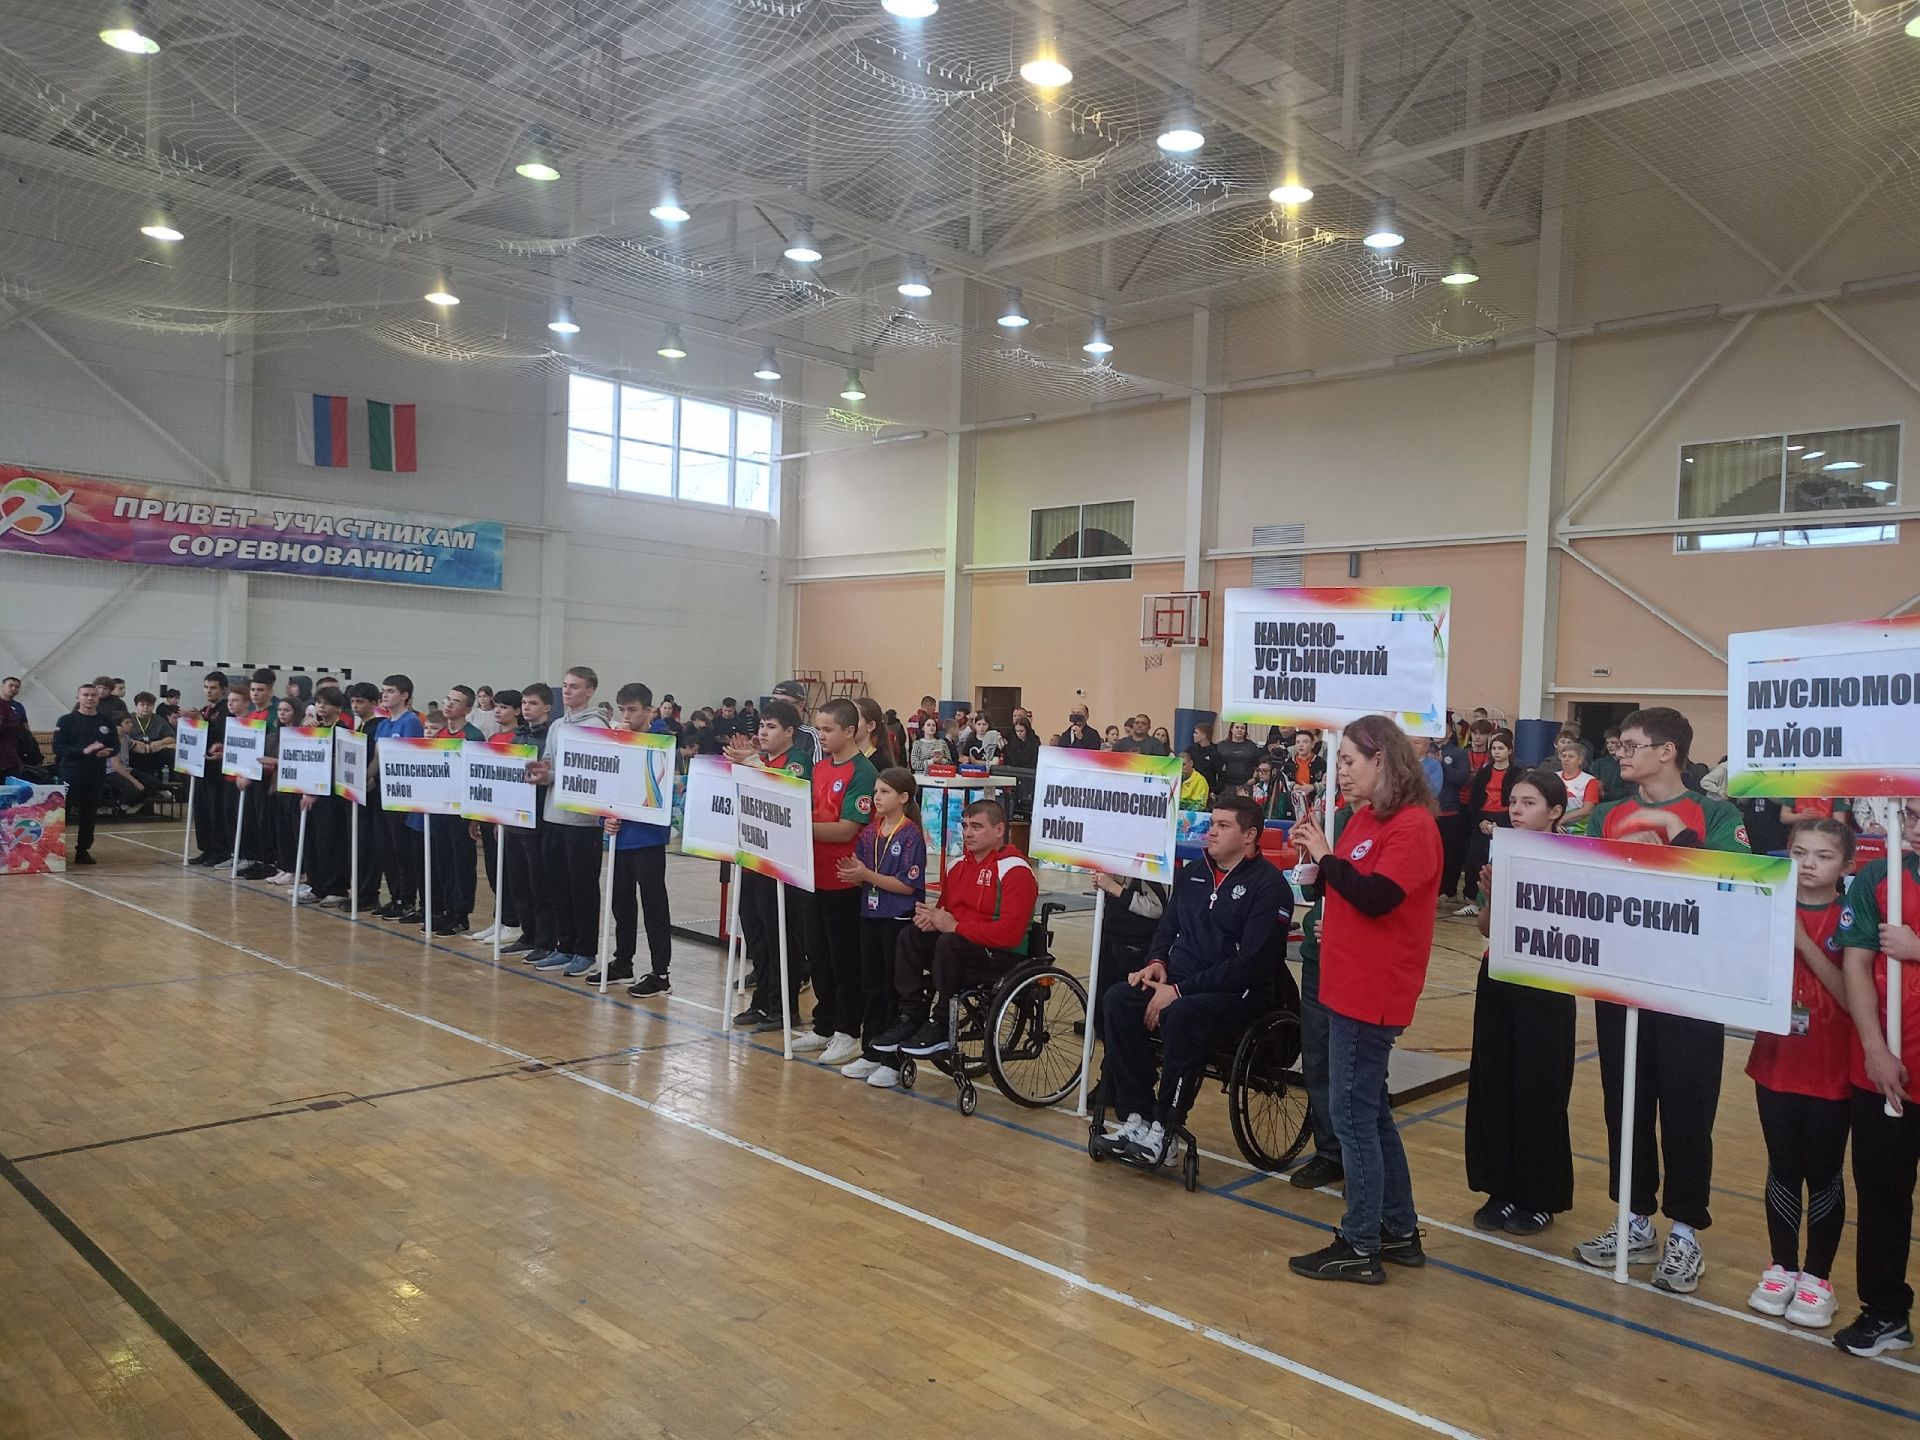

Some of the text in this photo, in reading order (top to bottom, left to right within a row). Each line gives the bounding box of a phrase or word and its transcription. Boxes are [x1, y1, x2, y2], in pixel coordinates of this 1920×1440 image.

[112, 495, 478, 550] ПРИВЕТ УЧАСТНИКАМ
[168, 533, 436, 574] СОРЕВНОВАНИЙ!
[1254, 621, 1345, 648] КАМСКО-
[1254, 645, 1389, 676] УСТЬИНСКИЙ
[1252, 672, 1317, 703] РАЙОН
[1746, 721, 1842, 758] РАЙОН
[281, 765, 298, 780] РАЙОН
[385, 762, 451, 779] БАЛТАСИНСКИЙ
[469, 763, 527, 783] БУГУЛЬМИНСКИ
[563, 751, 620, 774] БУИНСКИЙ
[386, 782, 412, 798] РАЙОН
[469, 783, 493, 803] РАЙОН
[562, 774, 597, 795] РАЙОН
[711, 794, 734, 816] КАЗ
[740, 794, 792, 828] НАБЕРЕЖНЫЕ
[1043, 784, 1168, 819] ДРОЖЖАНОВСКИЙ
[741, 822, 768, 850] ЧЕЛНЫ
[1042, 816, 1084, 842] РАЙОН
[1516, 881, 1700, 935] КУКМОРСКИЙ
[1514, 925, 1600, 967] РАЙОН
